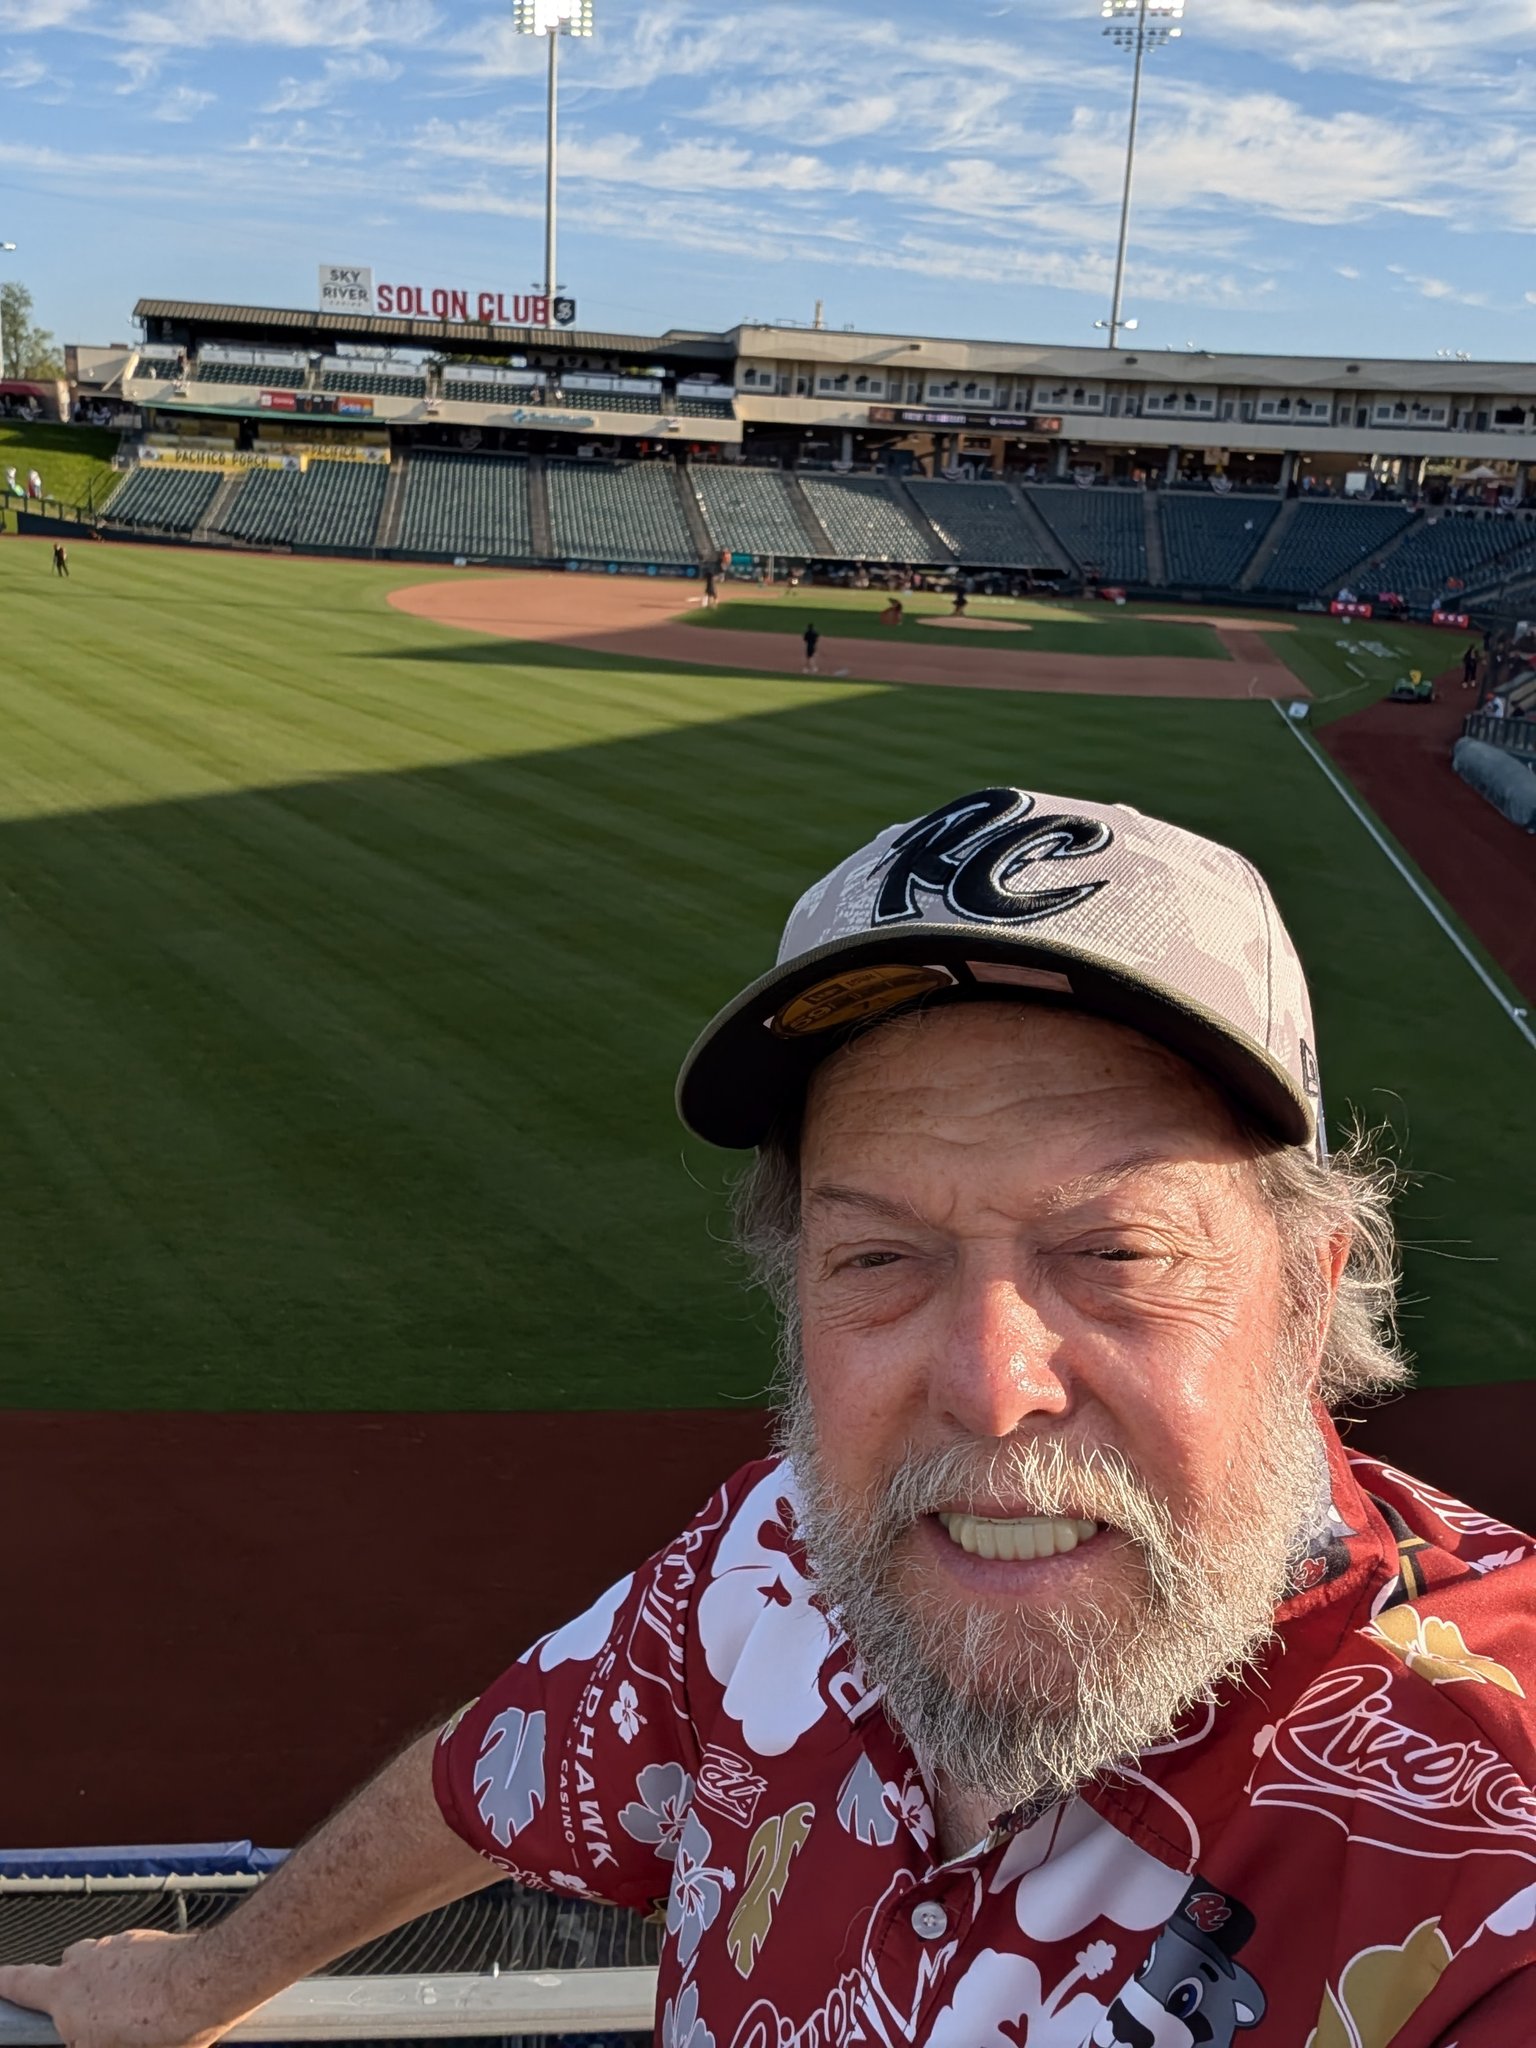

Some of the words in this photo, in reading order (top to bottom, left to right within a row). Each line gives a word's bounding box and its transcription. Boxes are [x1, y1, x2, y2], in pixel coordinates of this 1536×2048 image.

[329, 268, 361, 284] SKY
[322, 286, 369, 302] RIVER
[377, 284, 469, 321] SOLON
[477, 292, 549, 325] CLUB
[174, 450, 226, 466] PACIFICO
[231, 454, 269, 468] PORCH
[310, 444, 357, 459] PACIFICO
[559, 1758, 577, 1844] CASINO
